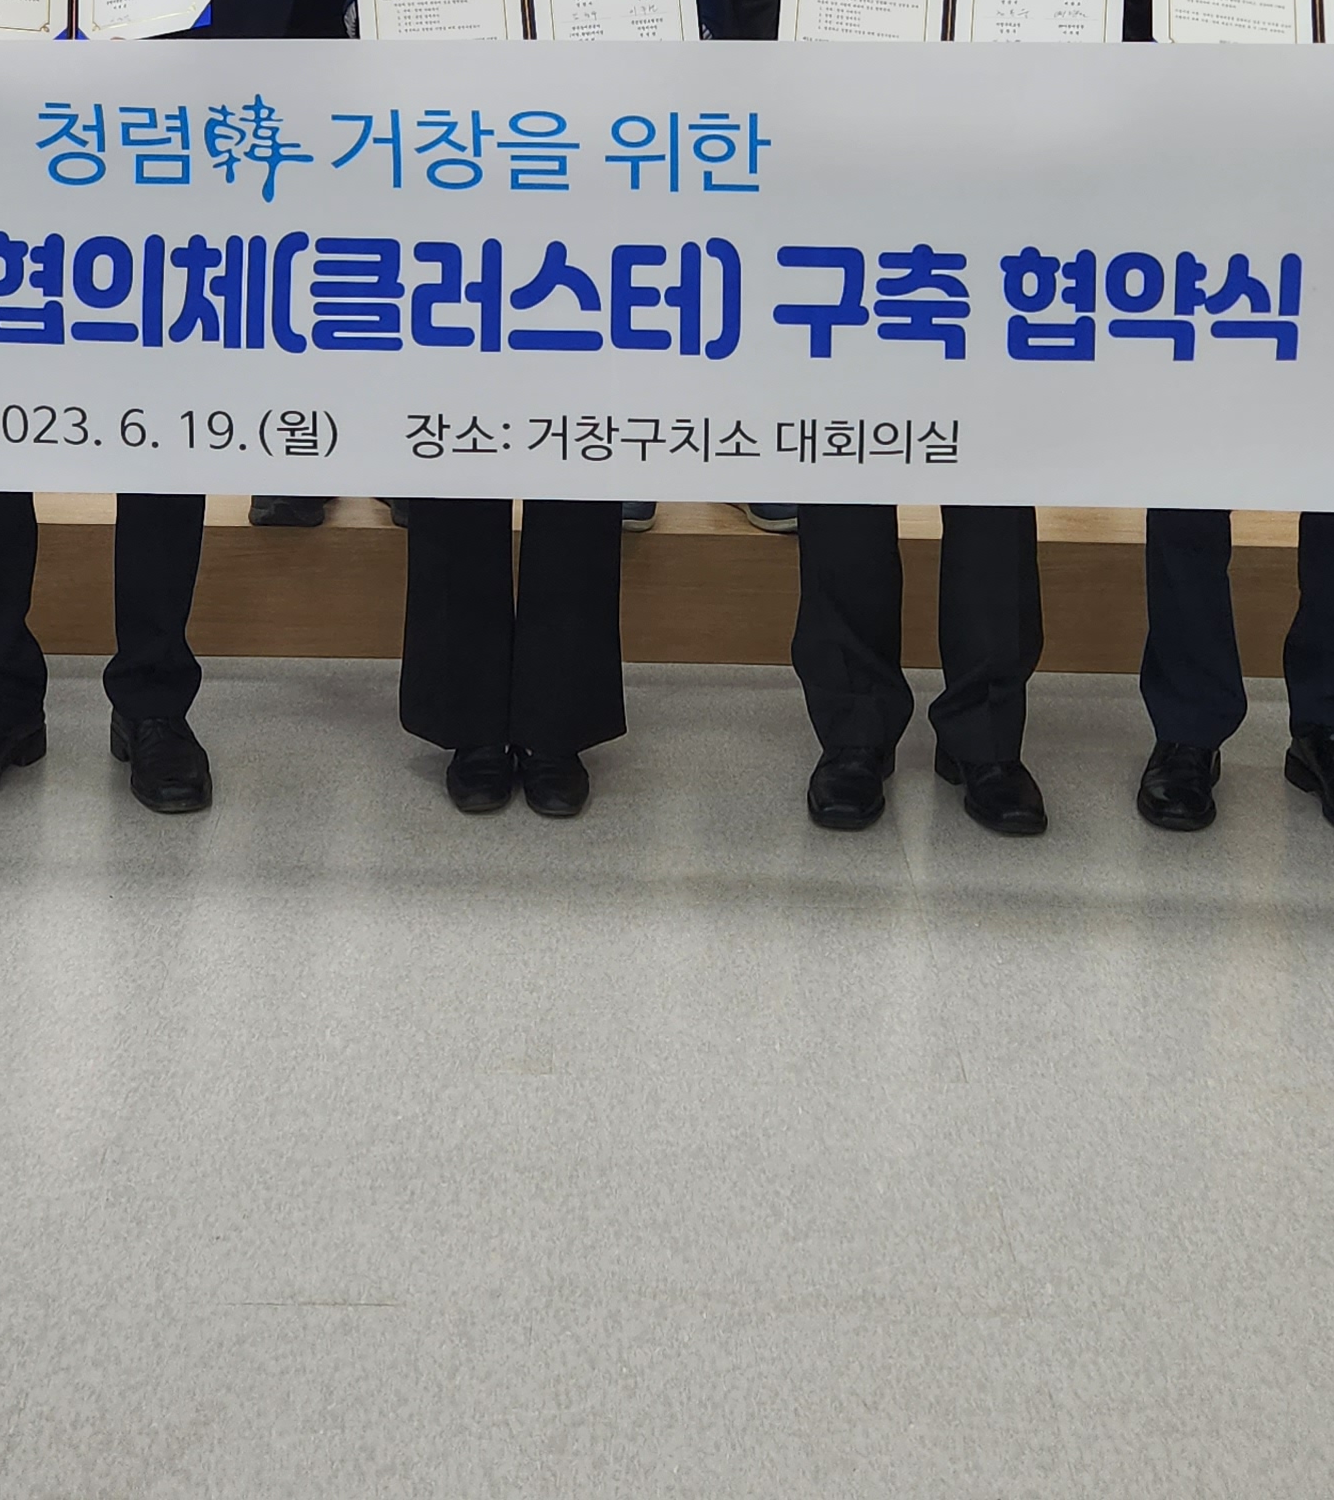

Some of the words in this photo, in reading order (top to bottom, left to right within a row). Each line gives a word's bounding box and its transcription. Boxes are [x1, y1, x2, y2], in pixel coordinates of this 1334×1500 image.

[36, 94, 315, 203] 청렴韓
[331, 110, 580, 193] 거창을
[604, 111, 772, 194] 위한
[772, 244, 970, 360] 구축
[999, 246, 1303, 361] 협약식
[120, 408, 159, 449] 6.
[405, 413, 511, 459] 장소:
[527, 415, 761, 463] 거창구치소
[776, 418, 959, 465] 대회의실
